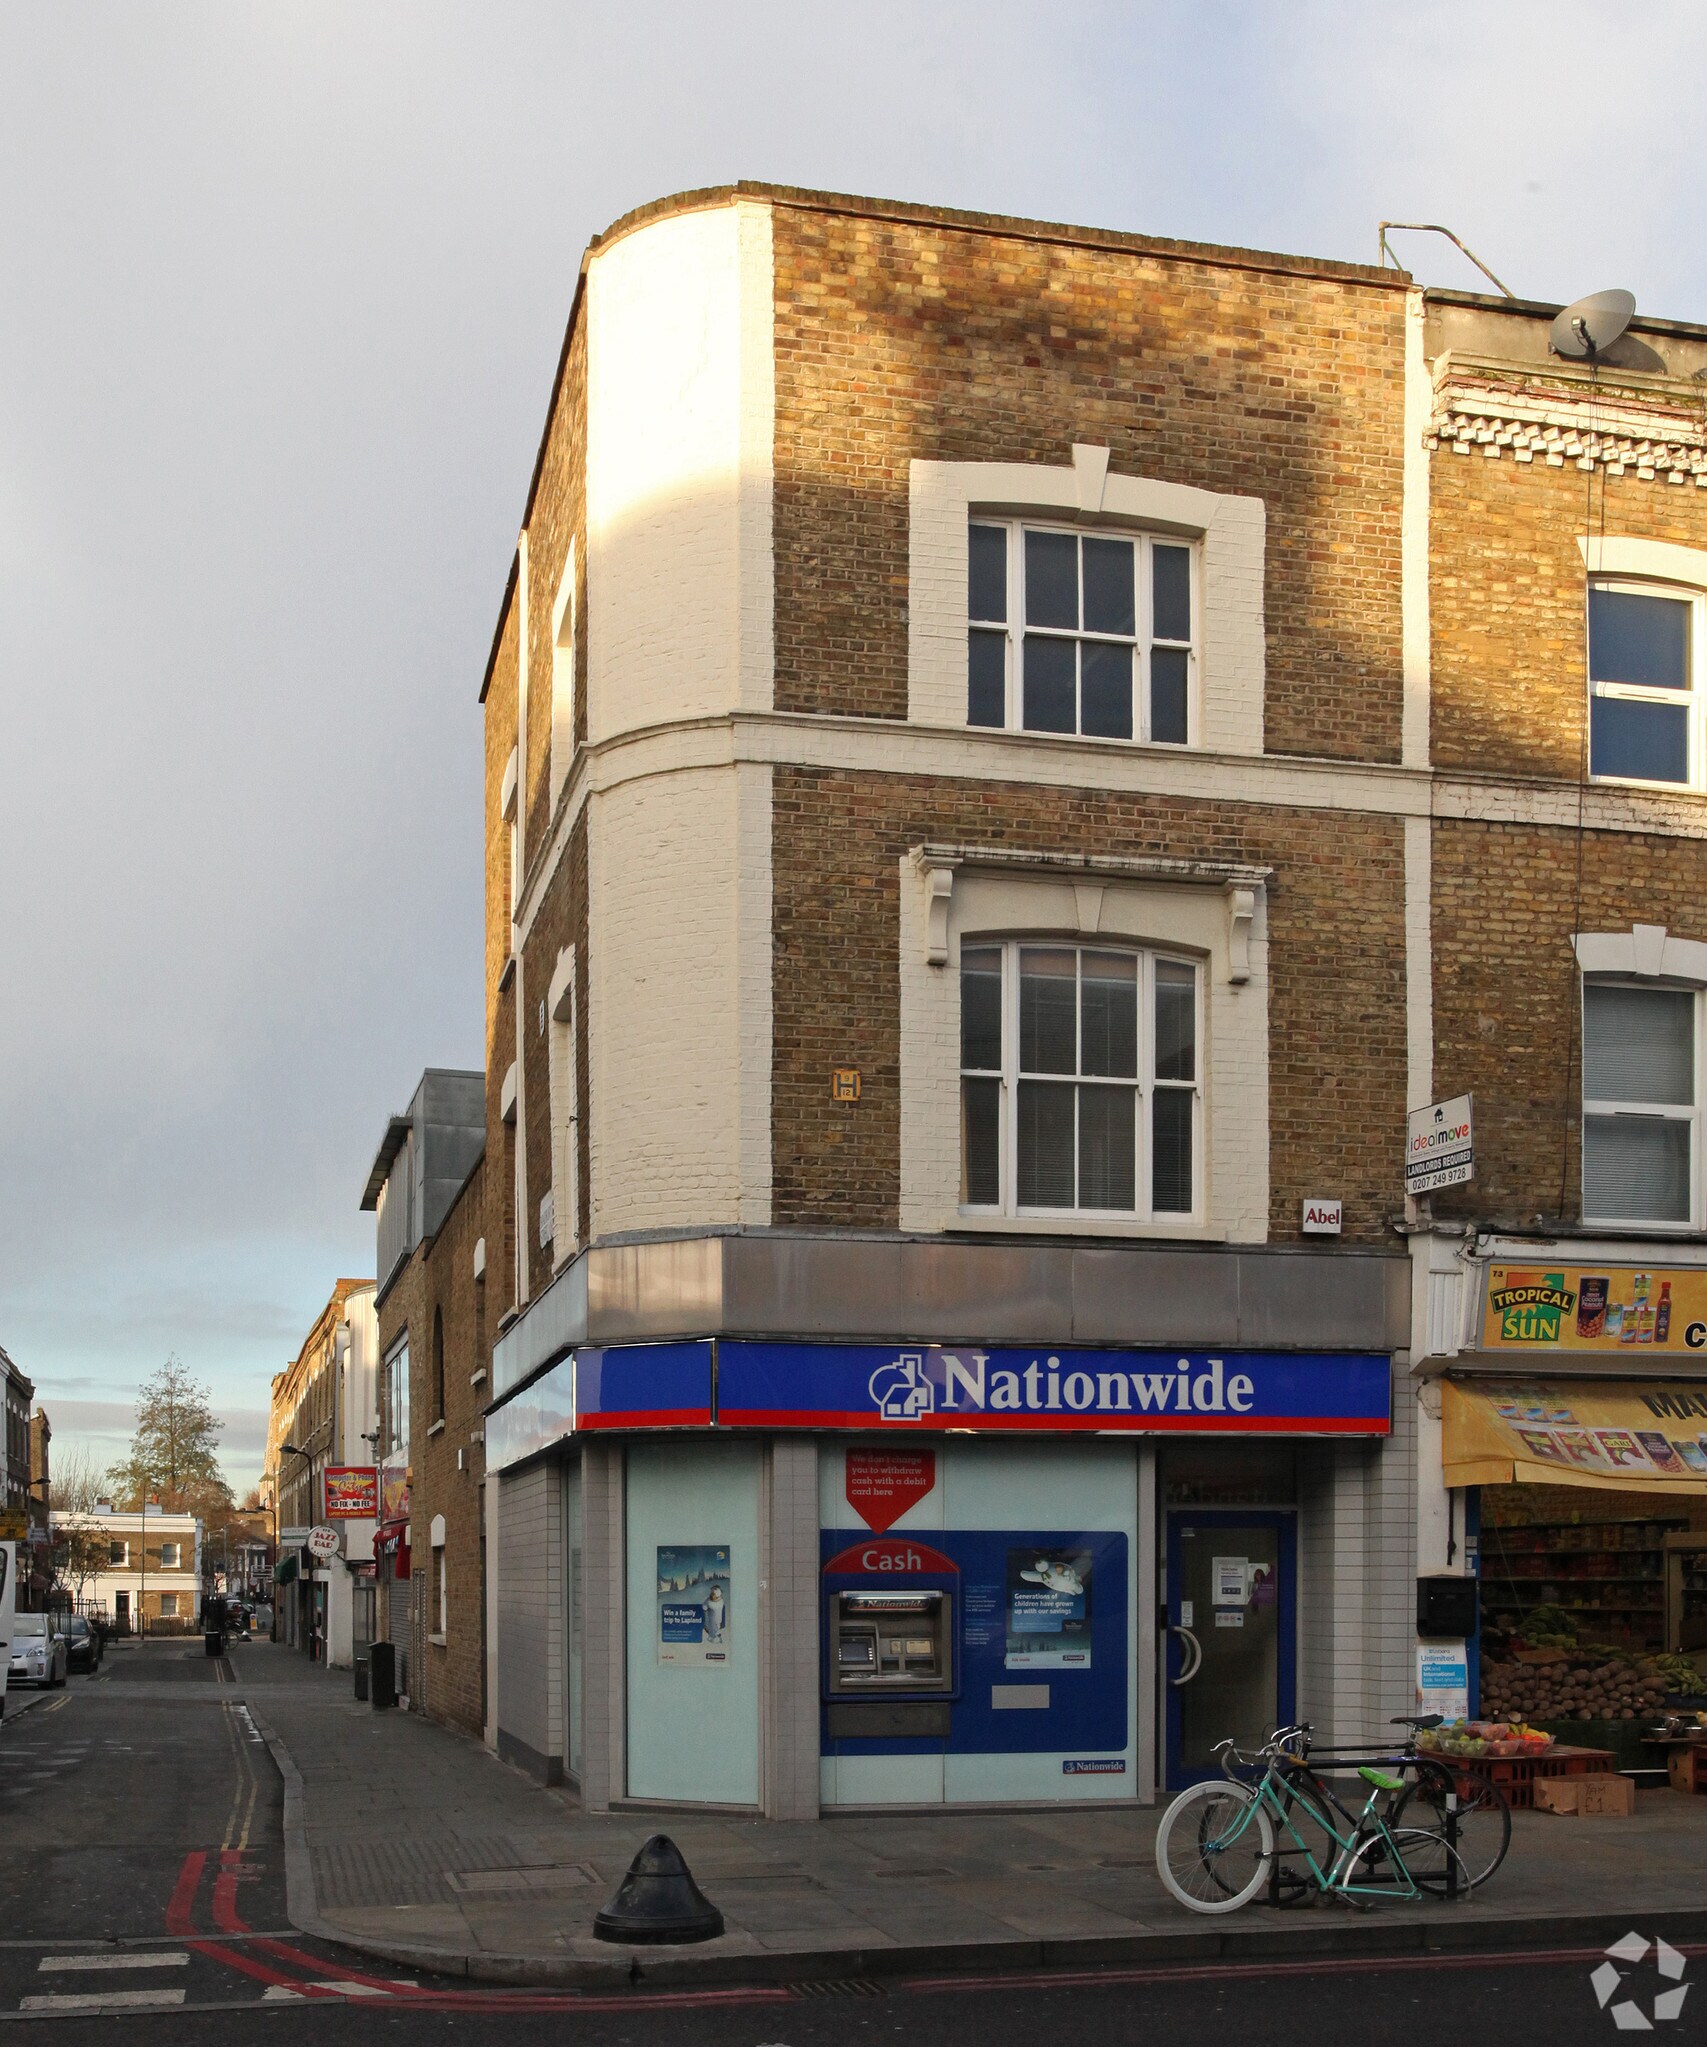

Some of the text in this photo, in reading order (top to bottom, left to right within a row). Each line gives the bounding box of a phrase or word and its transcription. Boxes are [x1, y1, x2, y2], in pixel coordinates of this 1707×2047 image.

[842, 1089, 851, 1097] 12
[1411, 1124, 1469, 1151] idealmove
[1407, 1158, 1441, 1177] LANDLORDS
[1442, 1150, 1471, 1168] REQUIRED
[1412, 1167, 1466, 1190] 0207 249 9728
[1305, 1207, 1340, 1225] Abel
[1492, 1270, 1504, 1278] 73
[1493, 1287, 1570, 1309] TROPICAL
[1503, 1317, 1559, 1340] SUN
[940, 1354, 1255, 1413] Nationwide
[1604, 1439, 1631, 1447] GARI
[851, 1454, 922, 1465] We don't charge
[851, 1466, 923, 1475] you to withdraw
[358, 1473, 375, 1481] Phone
[851, 1477, 872, 1485] cash
[875, 1477, 894, 1485] with
[903, 1477, 927, 1486] debit
[851, 1487, 893, 1496] card here
[330, 1500, 339, 1508] NO
[340, 1500, 348, 1508] FIX
[352, 1500, 360, 1508] NO
[313, 1532, 337, 1541] JAZZ
[861, 1549, 921, 1571] Cash
[867, 1599, 926, 1608] Nationwide
[679, 1609, 696, 1617] family
[663, 1617, 673, 1625] trip
[681, 1617, 702, 1625] Lapland
[1076, 1761, 1124, 1771] Nationwide
[1585, 1783, 1606, 1796] YAM
